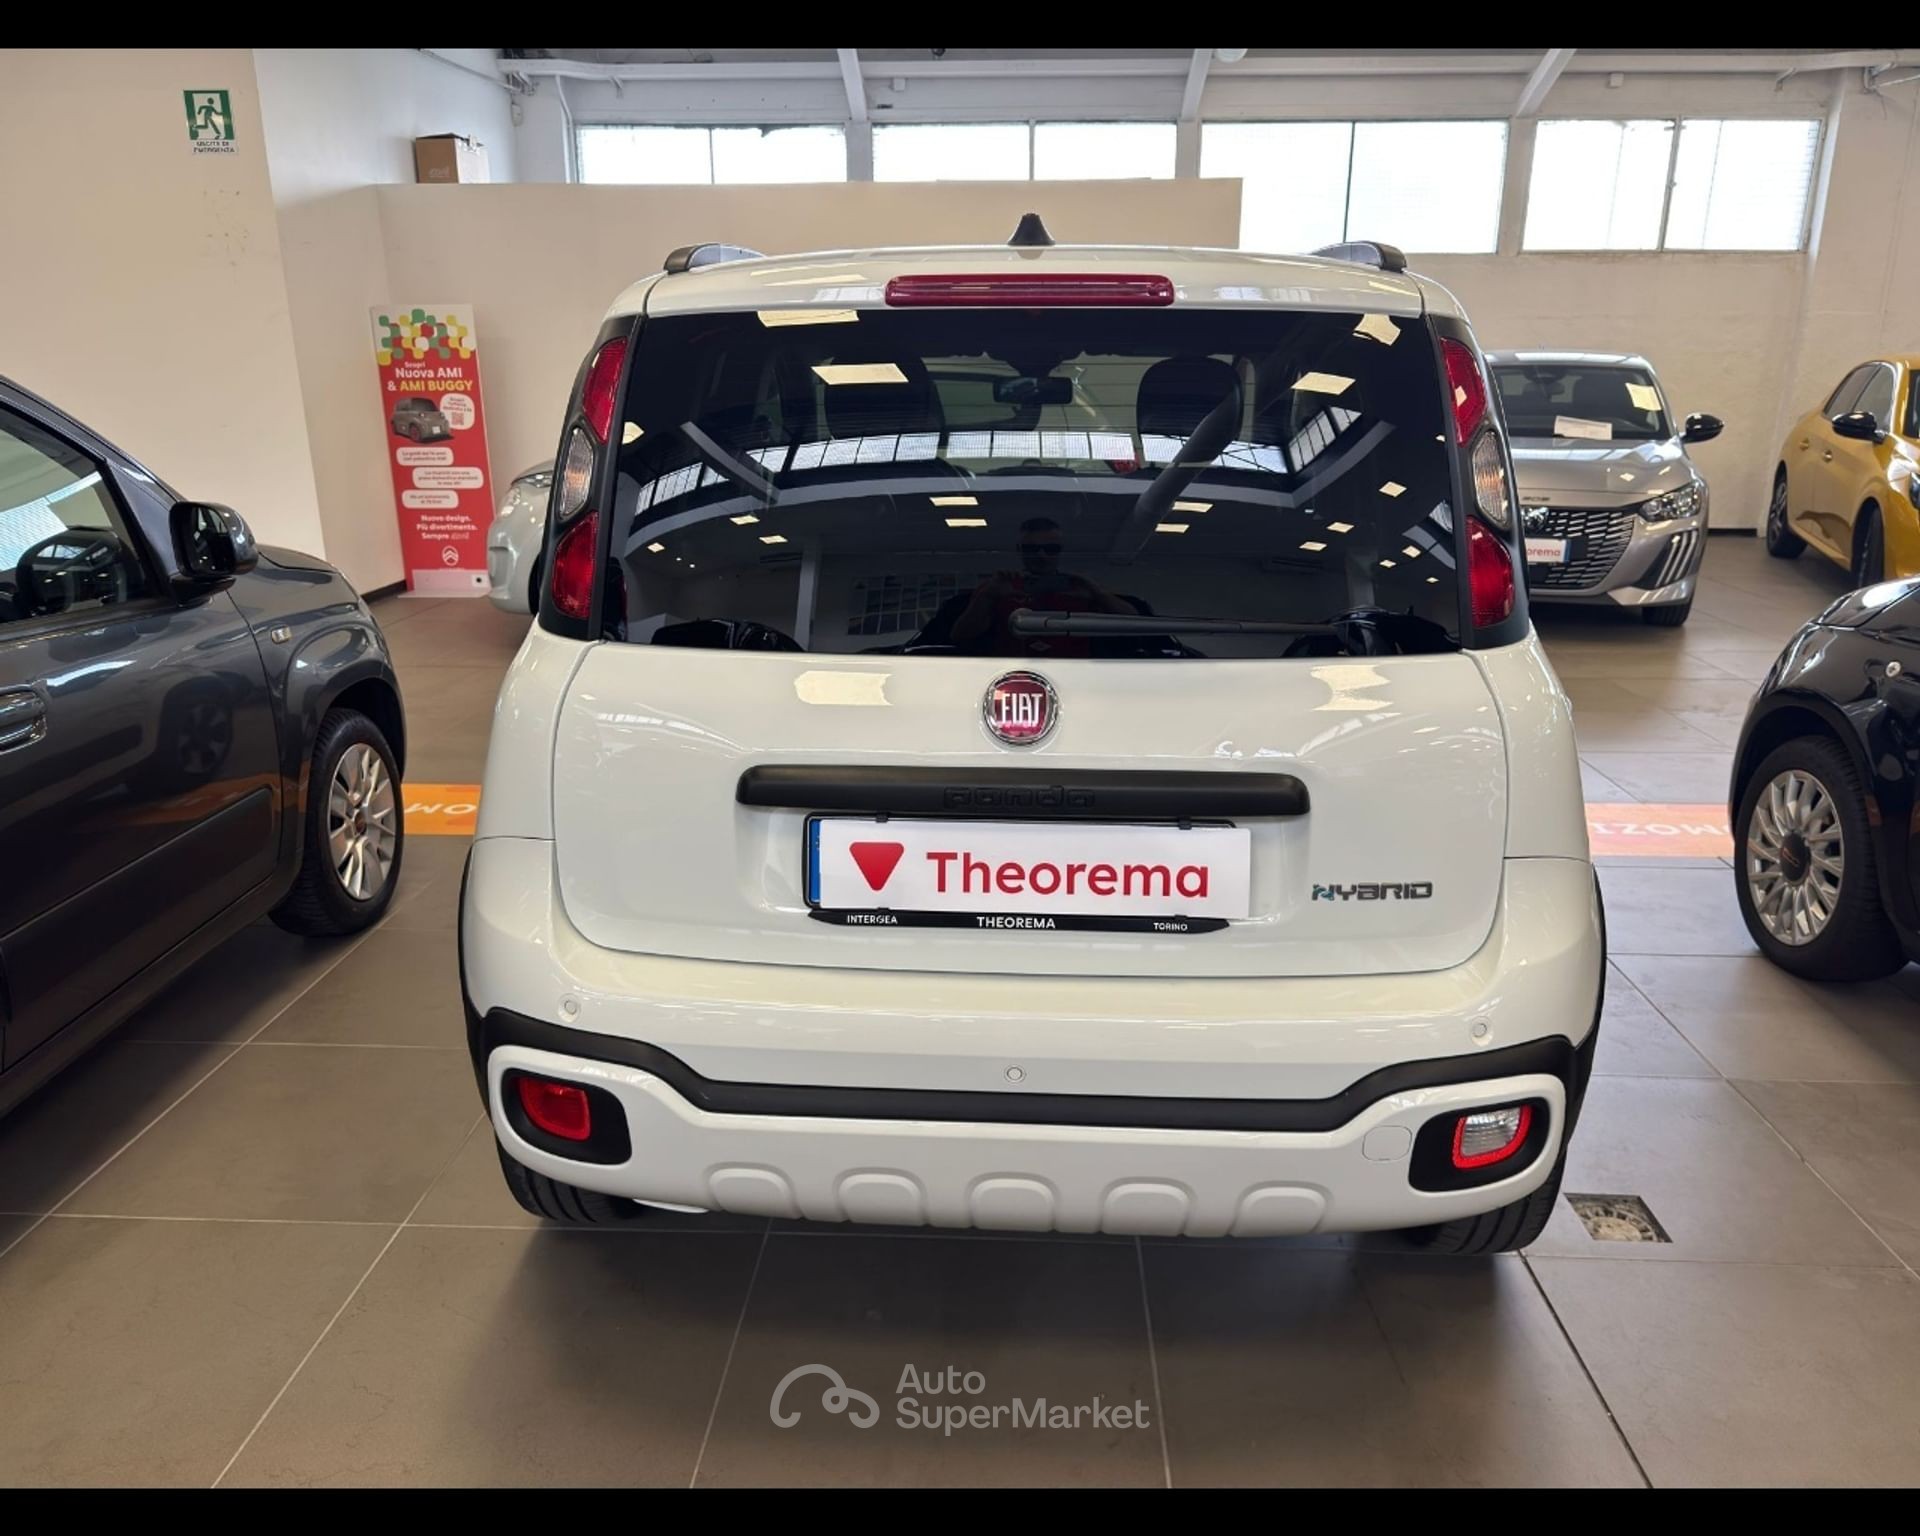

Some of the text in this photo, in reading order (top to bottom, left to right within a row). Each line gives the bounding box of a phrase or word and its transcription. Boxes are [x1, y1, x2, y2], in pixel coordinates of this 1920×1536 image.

[395, 367, 463, 378] Nuova AMI
[387, 380, 473, 391] & AMI BUGGY
[421, 532, 450, 540] Sempre
[1001, 693, 1043, 727] FIAT
[927, 852, 1208, 898] Theorema
[847, 915, 1188, 932] INTERGEA THEOREMA TORINO
